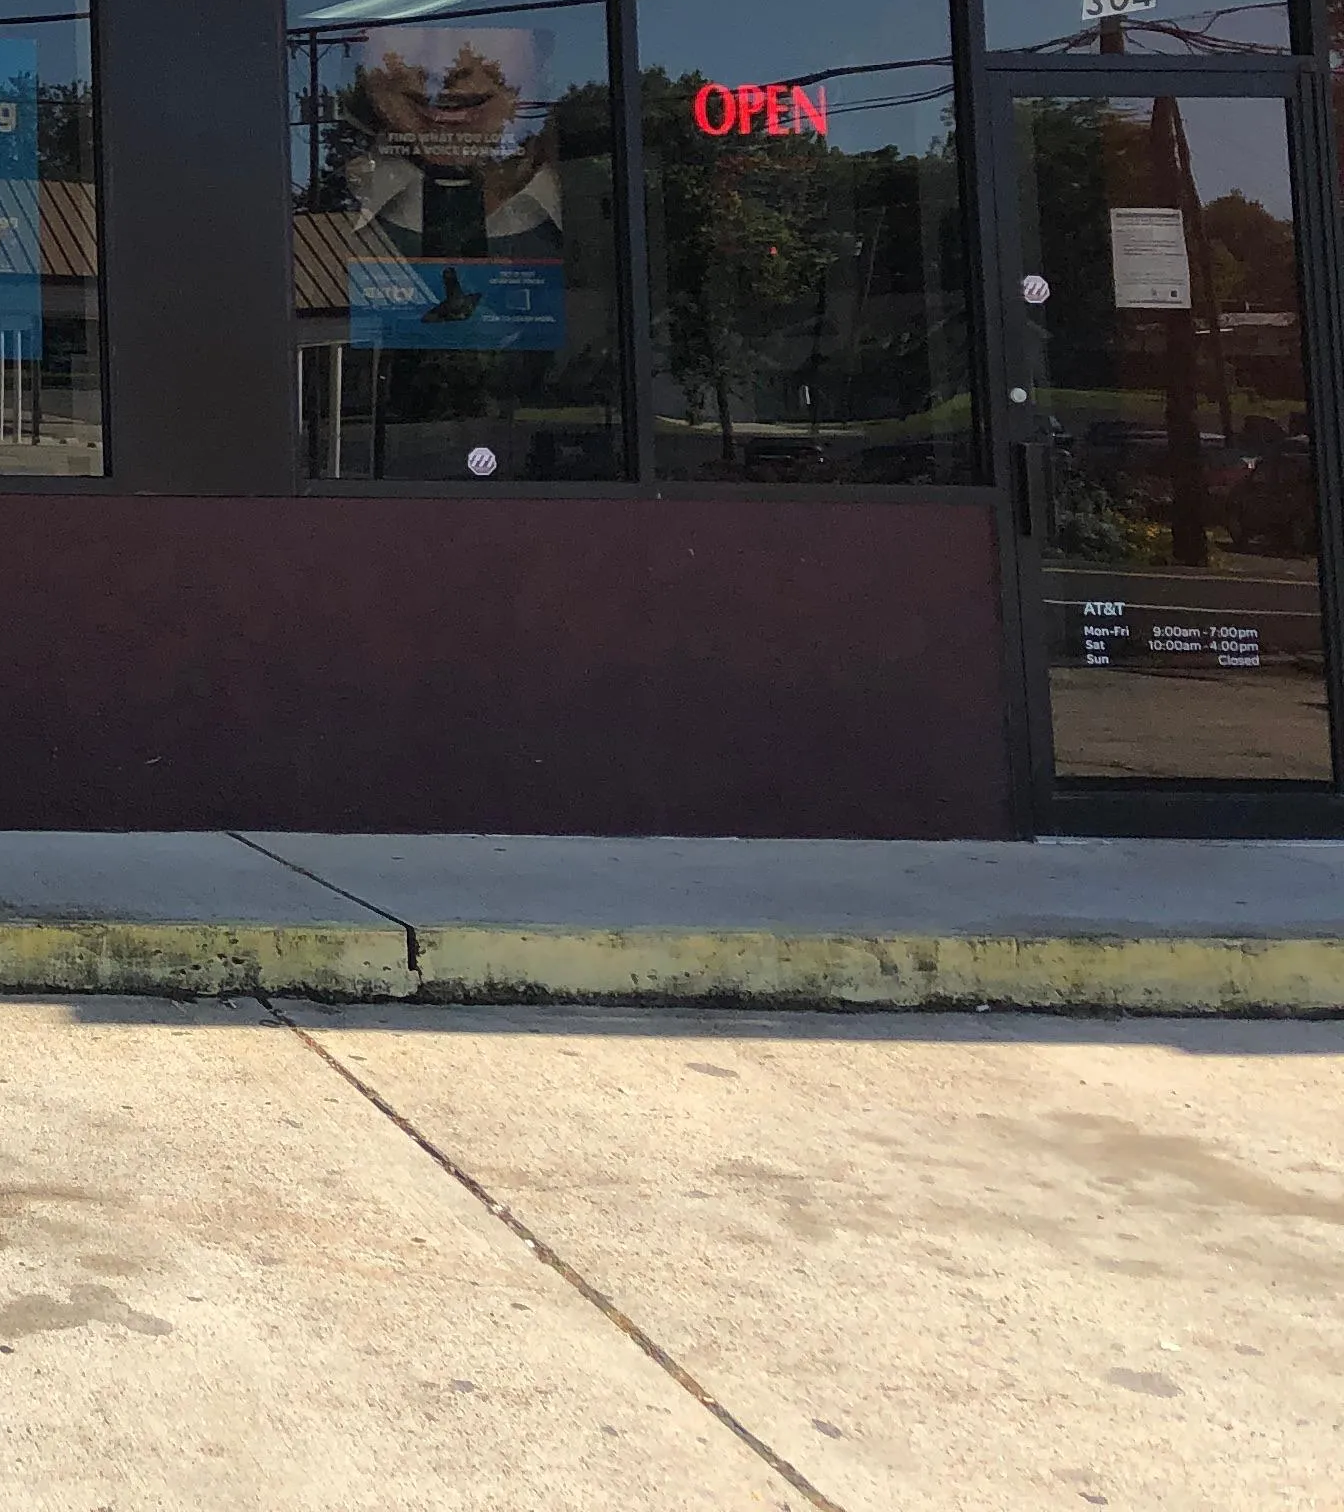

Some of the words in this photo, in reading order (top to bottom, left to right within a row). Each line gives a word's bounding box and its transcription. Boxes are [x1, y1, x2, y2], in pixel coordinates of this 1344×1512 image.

[694, 83, 829, 137] OPEN
[378, 145, 411, 155] WITH
[1083, 602, 1125, 616] AT&T
[1084, 626, 1130, 637] Mon-Fri
[1153, 626, 1201, 637] 9:00am
[1209, 627, 1259, 639] 7:00pm
[1085, 640, 1106, 651] Sat
[1148, 640, 1202, 651] 10:00am
[1209, 640, 1259, 653] 4:00pm
[1086, 654, 1110, 665] Sun
[1218, 655, 1260, 666] Closed
